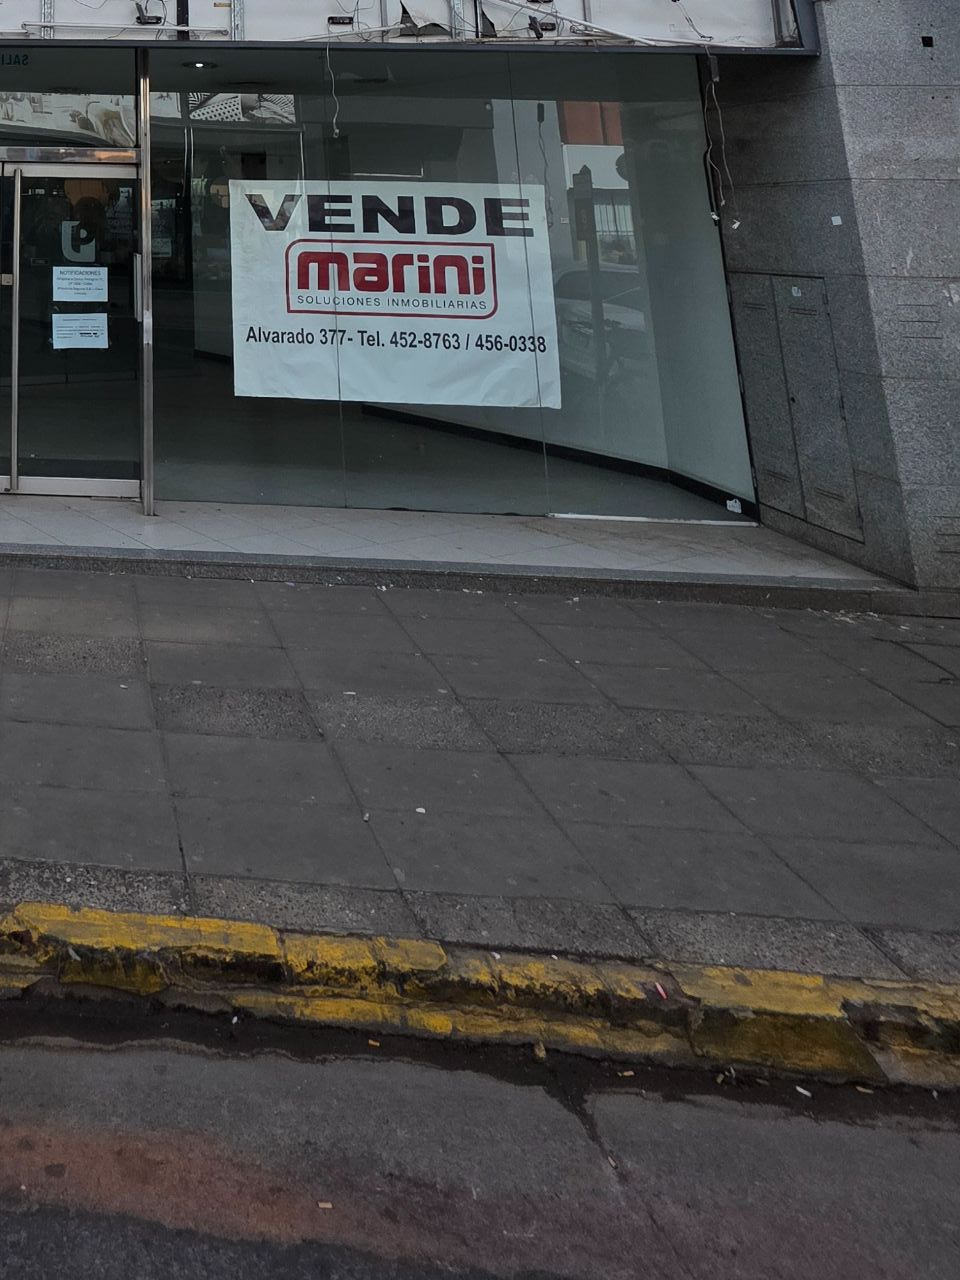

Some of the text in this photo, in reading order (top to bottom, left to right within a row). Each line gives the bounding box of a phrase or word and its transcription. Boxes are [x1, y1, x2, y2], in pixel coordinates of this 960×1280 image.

[244, 193, 534, 237] VENDE
[297, 251, 485, 296] marini
[297, 295, 487, 310] SOLUCIONES INMOBILIARIAS
[246, 326, 315, 345] Alvarado
[319, 328, 353, 346] 377-
[357, 330, 385, 347] Tel.
[390, 331, 461, 350] 452-8763
[475, 334, 547, 353] 456-0338
